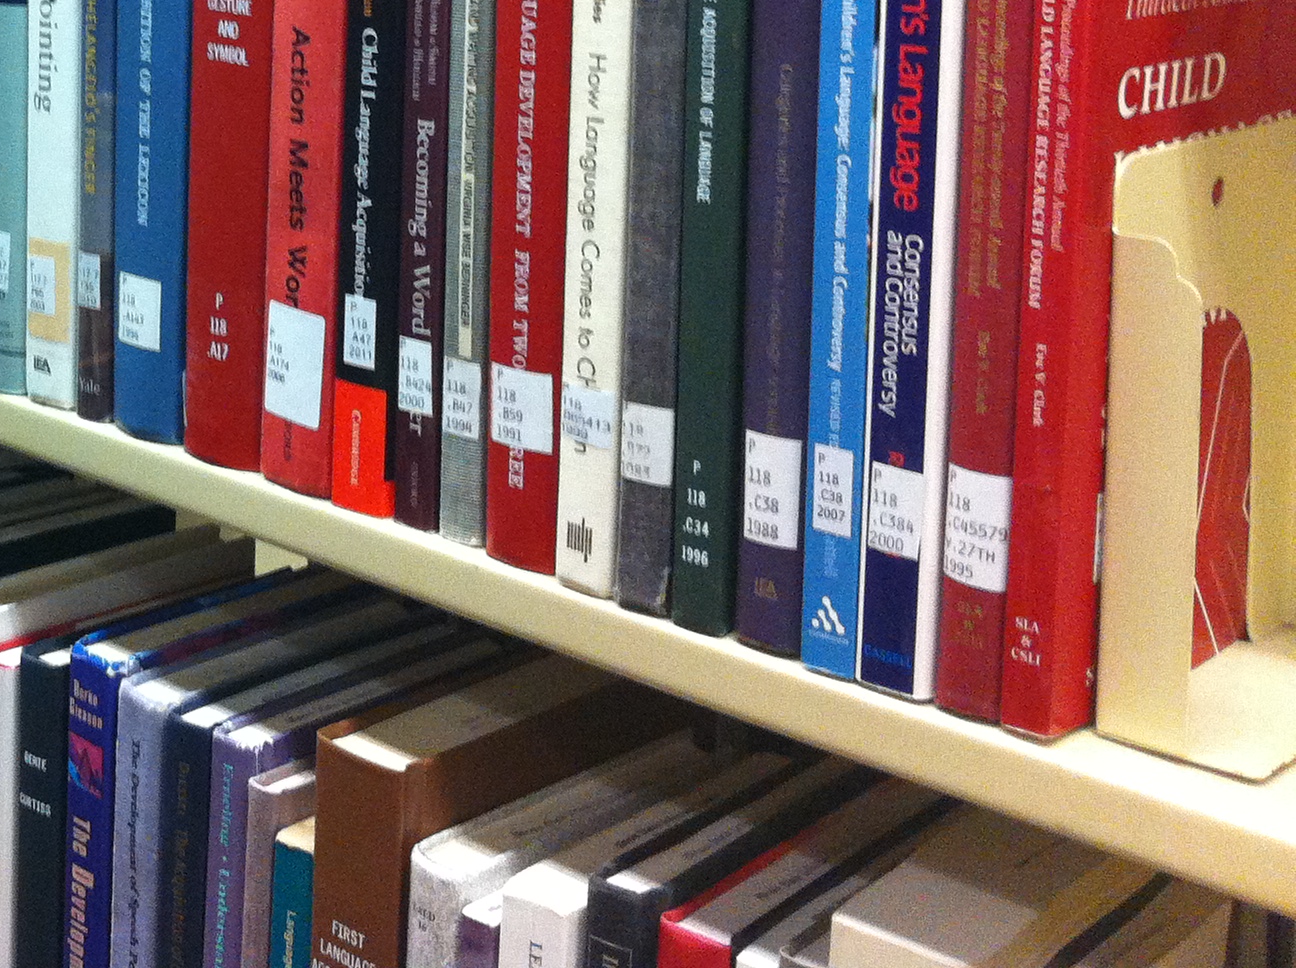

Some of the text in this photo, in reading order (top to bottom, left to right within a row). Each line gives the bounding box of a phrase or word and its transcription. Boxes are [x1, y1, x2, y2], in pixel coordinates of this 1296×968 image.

[215, 20, 242, 38] AND
[207, 42, 250, 66] SYMBOL
[139, 67, 153, 96] OF
[584, 53, 609, 109] How
[1034, 26, 1055, 130] LANGUAGE
[1117, 51, 1227, 120] CHILD
[353, 27, 380, 190] Child Language
[695, 8, 716, 203] ACQUISITION LANGUAGE
[831, 65, 856, 150] Language:
[286, 26, 312, 231] Action Meets
[887, 44, 930, 213] Language
[513, 70, 536, 238] DEVELOPMENT
[136, 143, 151, 227] LEXICON
[408, 117, 435, 238] Becoming
[577, 114, 607, 233] Language
[1028, 135, 1051, 237] RESEARCH
[833, 154, 852, 242] Consensus
[412, 244, 429, 260] a
[832, 245, 849, 280] and
[513, 250, 533, 313] FROM
[579, 238, 604, 321] Comes
[1026, 239, 1046, 312] FORUM
[409, 264, 432, 336] Word
[901, 232, 923, 356] Consensus
[210, 316, 228, 335] 118
[351, 318, 368, 330] 118
[826, 282, 847, 372] Controversy
[349, 345, 372, 360] 2011
[510, 320, 529, 371] TWO
[577, 327, 597, 354] to
[401, 355, 419, 372] 118
[400, 392, 425, 408] 2000
[446, 380, 466, 395] 118
[497, 386, 516, 402] 118
[498, 406, 523, 421] .B59
[496, 424, 522, 442] 1991
[748, 466, 772, 486] 118
[818, 470, 840, 486] 118
[687, 488, 706, 506] 118
[748, 492, 780, 513] .C38
[873, 488, 898, 508] 118
[949, 492, 970, 512] 118
[817, 506, 846, 522] 2007
[747, 517, 779, 540] 1988
[870, 531, 904, 552] 2000
[682, 545, 709, 567] 1996
[944, 556, 974, 578] 1995
[1011, 647, 1040, 666] CSLI
[72, 816, 92, 855] The
[128, 781, 141, 869] Development
[331, 920, 365, 948] FIRST
